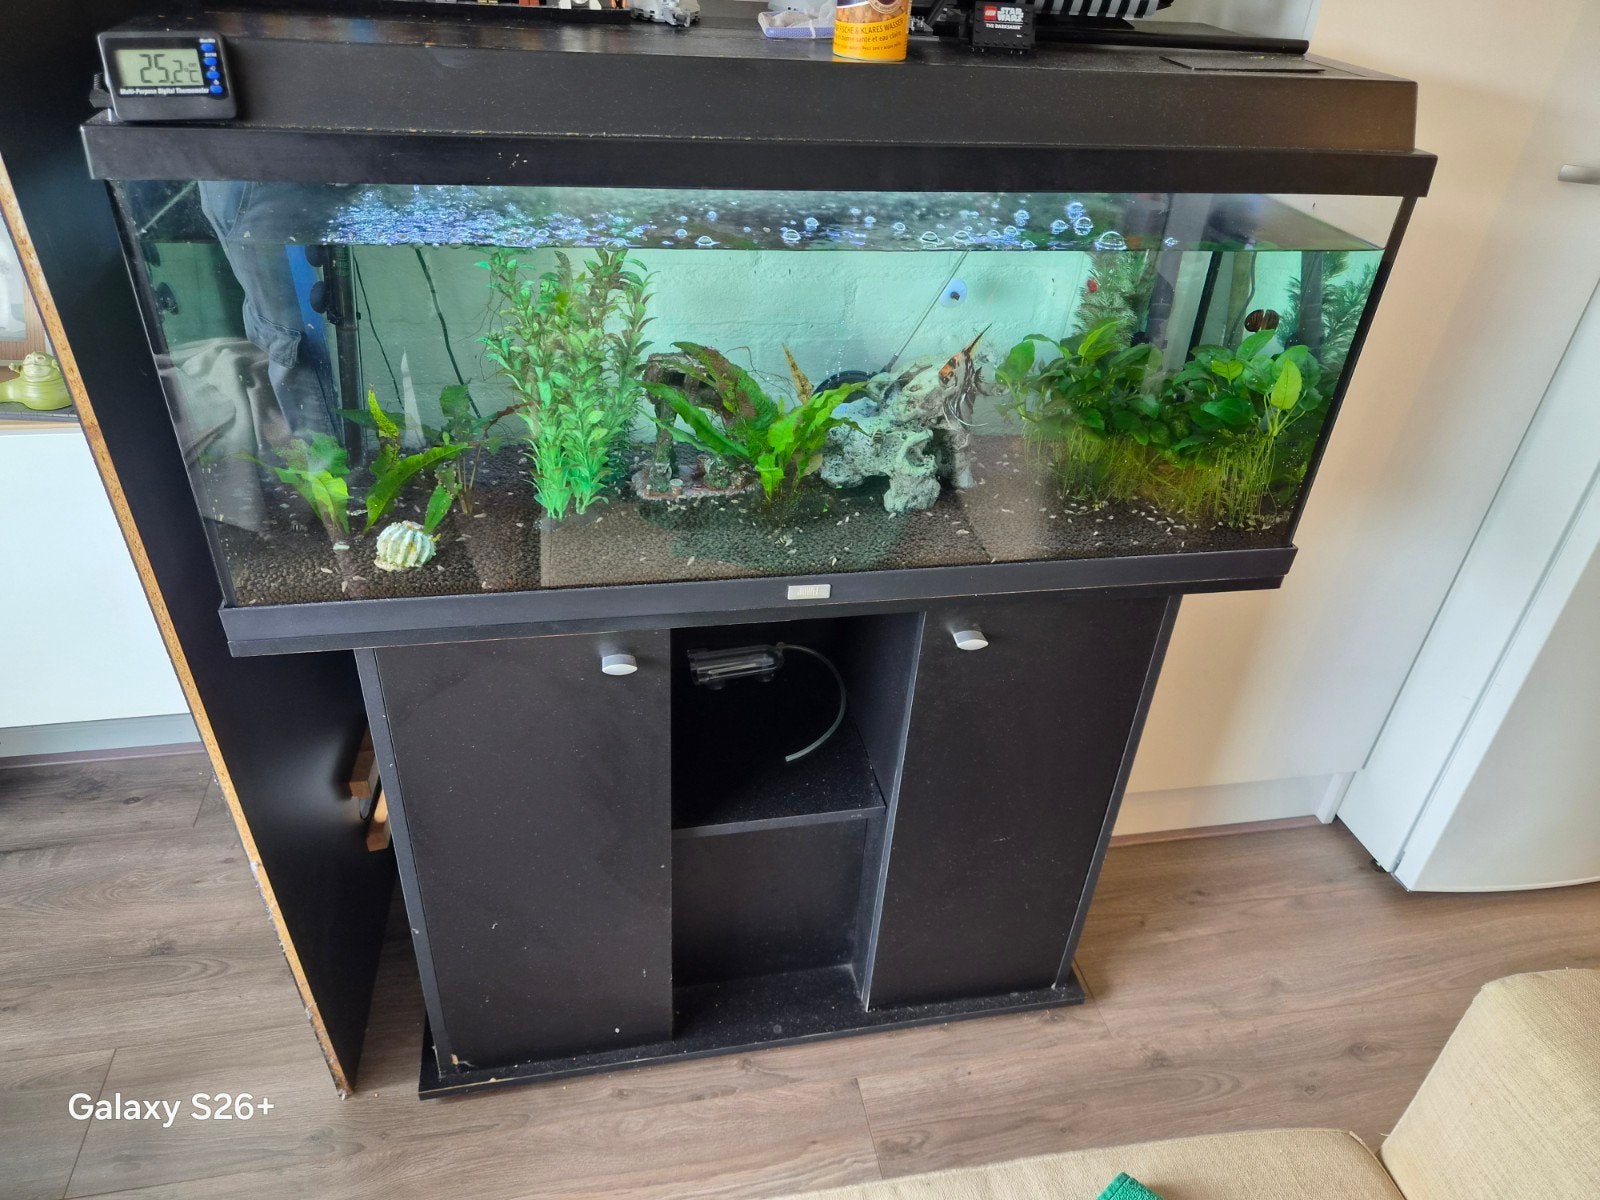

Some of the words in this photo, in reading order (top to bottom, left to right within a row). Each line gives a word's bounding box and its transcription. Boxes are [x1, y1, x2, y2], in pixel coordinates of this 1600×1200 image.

[1000, 7, 1022, 15] STAR
[997, 11, 1024, 22] WARS
[860, 25, 883, 34] KLARES
[120, 87, 157, 96] Multi-Purpose
[157, 87, 175, 96] Digital
